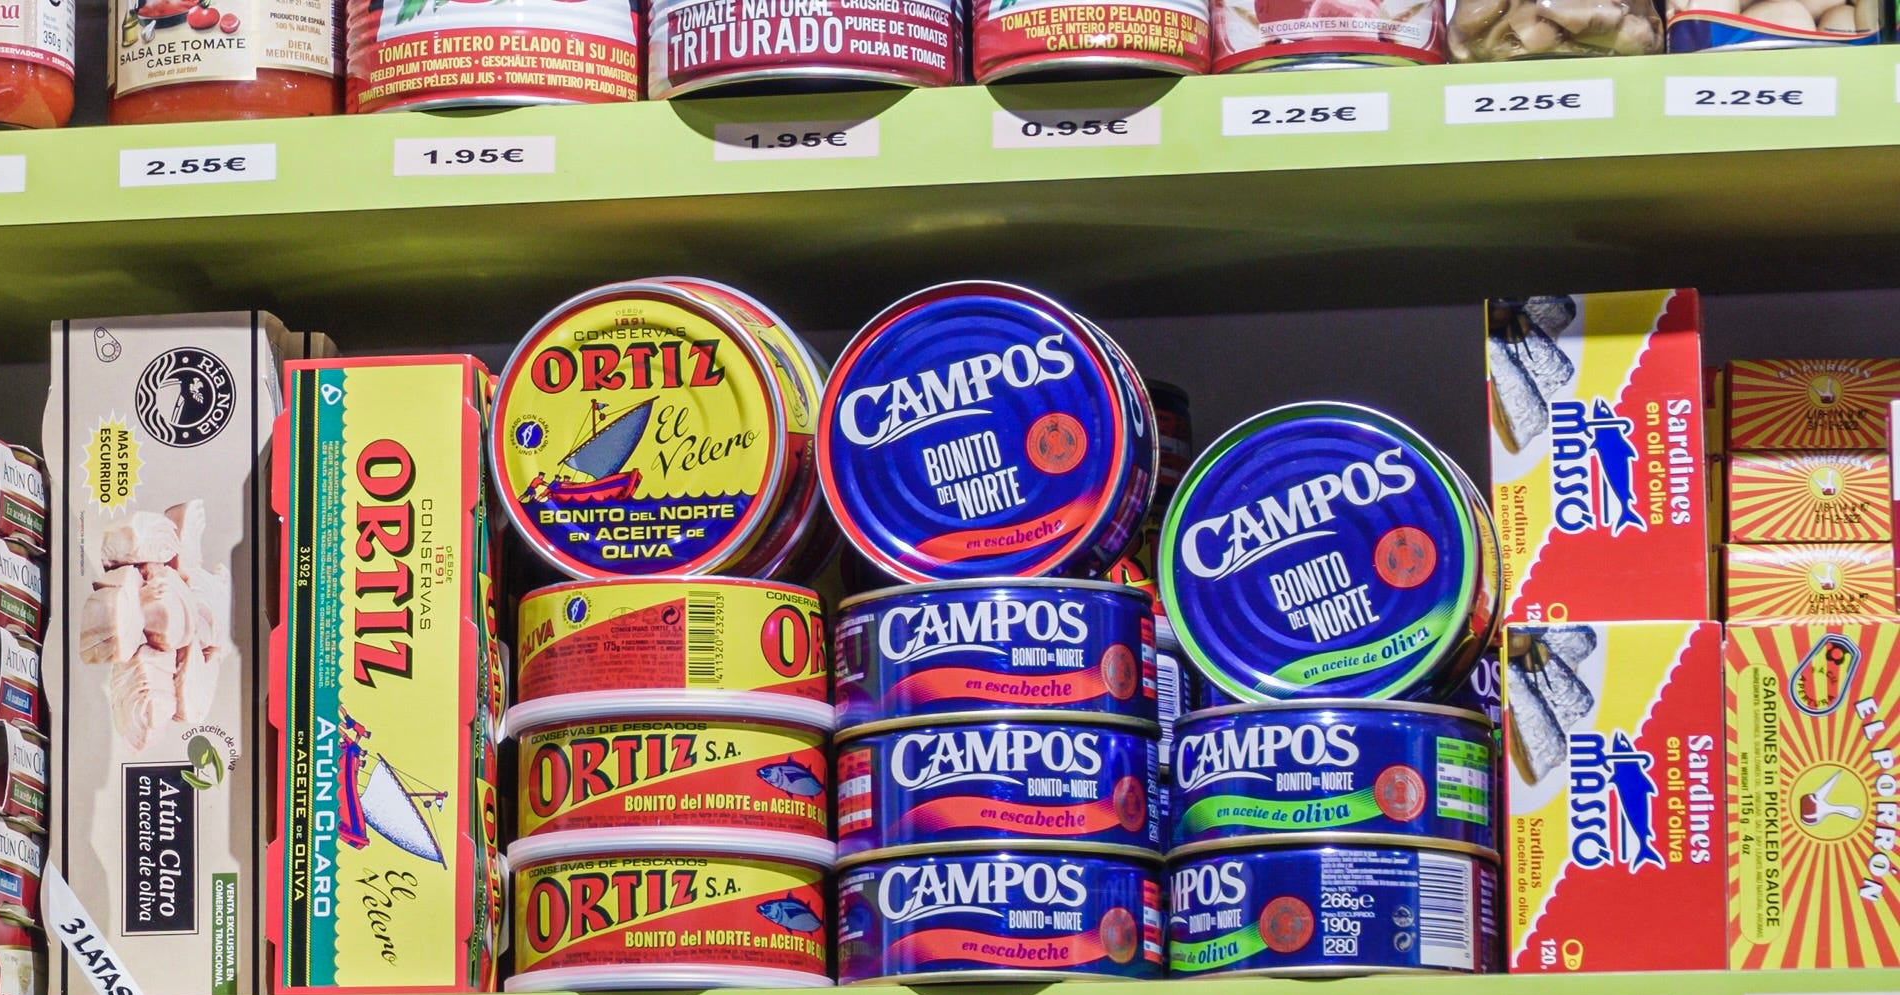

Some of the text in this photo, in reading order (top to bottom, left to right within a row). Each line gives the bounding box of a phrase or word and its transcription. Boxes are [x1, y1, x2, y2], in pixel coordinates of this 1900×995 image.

[1260, 24, 1275, 35] SIN
[1278, 21, 1334, 33] COLORANTES
[1339, 20, 1349, 29] NI
[120, 38, 246, 66] SALSA DE TOMATE
[378, 36, 636, 68] TOMATE ENTERO PELADO EN SU JUGO
[671, 16, 843, 71] TRITURADO
[1046, 34, 1184, 56] CALIDAD PRIMERA
[147, 54, 201, 68] CASERA
[1473, 92, 1582, 114] 2.25€
[1694, 89, 1804, 107] 2.25€
[1020, 119, 1130, 138] 0.95€
[1250, 106, 1358, 126] 2.25€
[744, 130, 849, 150] 1.95€
[145, 155, 248, 176] 2.55€
[422, 146, 525, 166] 1.95€
[531, 340, 726, 394] ORTIZ
[839, 334, 1075, 446] CAMPOS
[922, 430, 1001, 486] BONITO
[1667, 399, 1694, 525] Sardines
[937, 467, 1026, 520] DEL NORTE
[539, 504, 734, 524] BONITO DEL NORTE
[1181, 447, 1416, 579] CAMPOS
[353, 439, 416, 688] ORTIZ
[891, 731, 1101, 786] CAMPOS
[1763, 676, 1781, 927] SARDINES in PICKLED SAUCE
[159, 778, 181, 918] Atún Claro
[1322, 918, 1360, 936] 190g
[1325, 939, 1354, 954] 280
